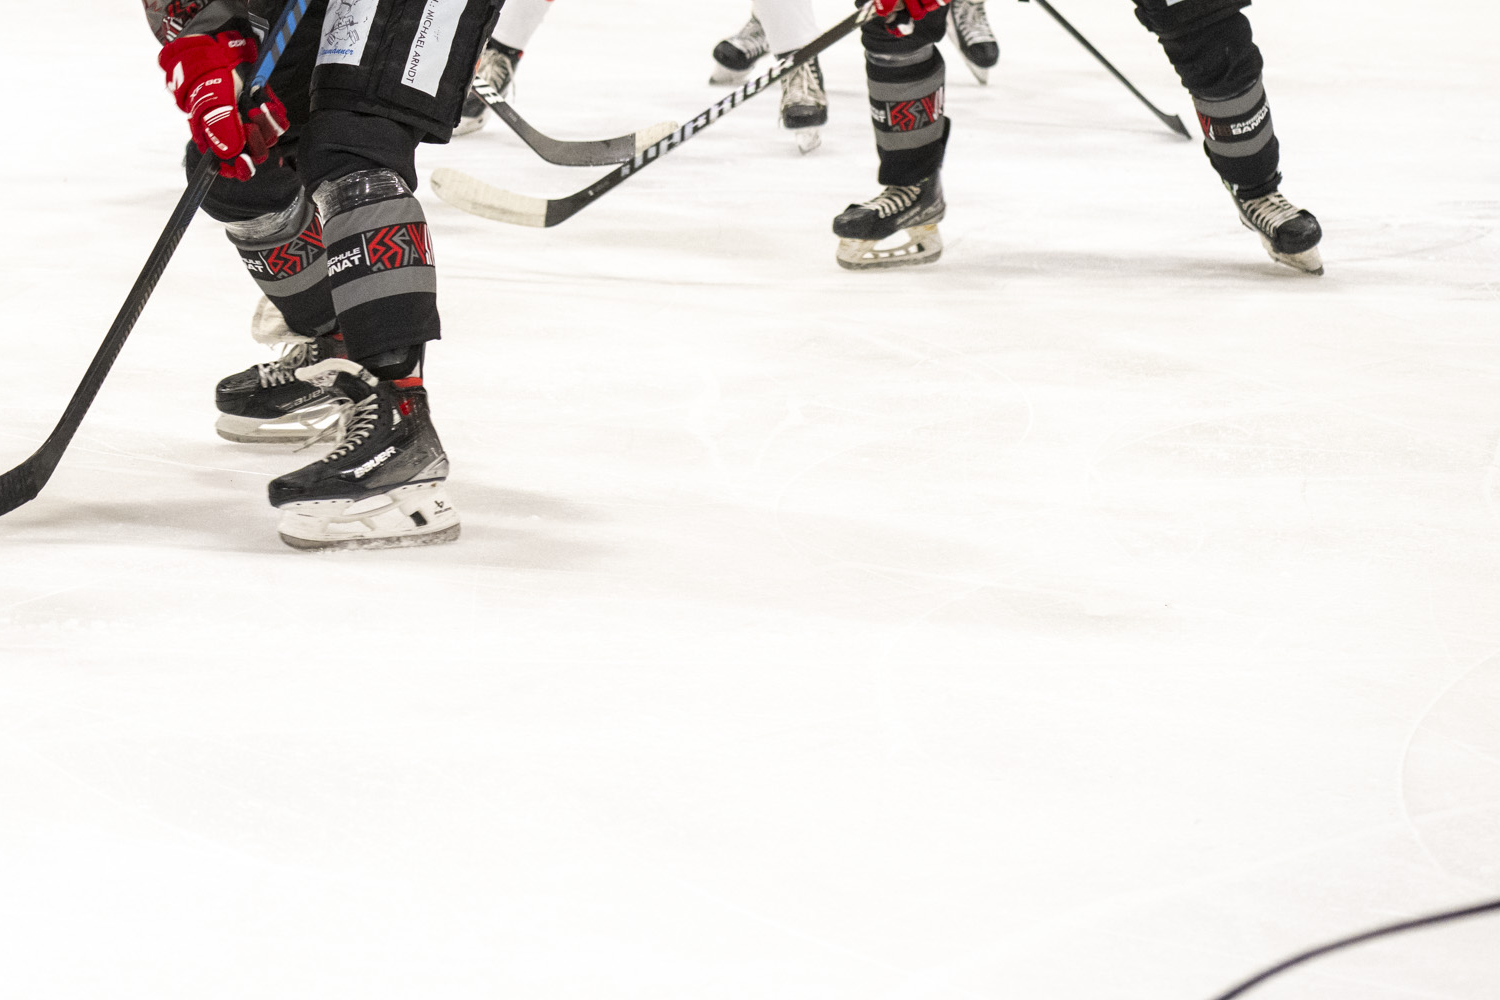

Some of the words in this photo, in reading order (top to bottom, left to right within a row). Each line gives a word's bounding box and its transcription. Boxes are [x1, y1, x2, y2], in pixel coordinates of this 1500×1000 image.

[415, 9, 434, 50] MICHAEL
[404, 51, 422, 86] ARNDT
[353, 446, 397, 479] BAUER
